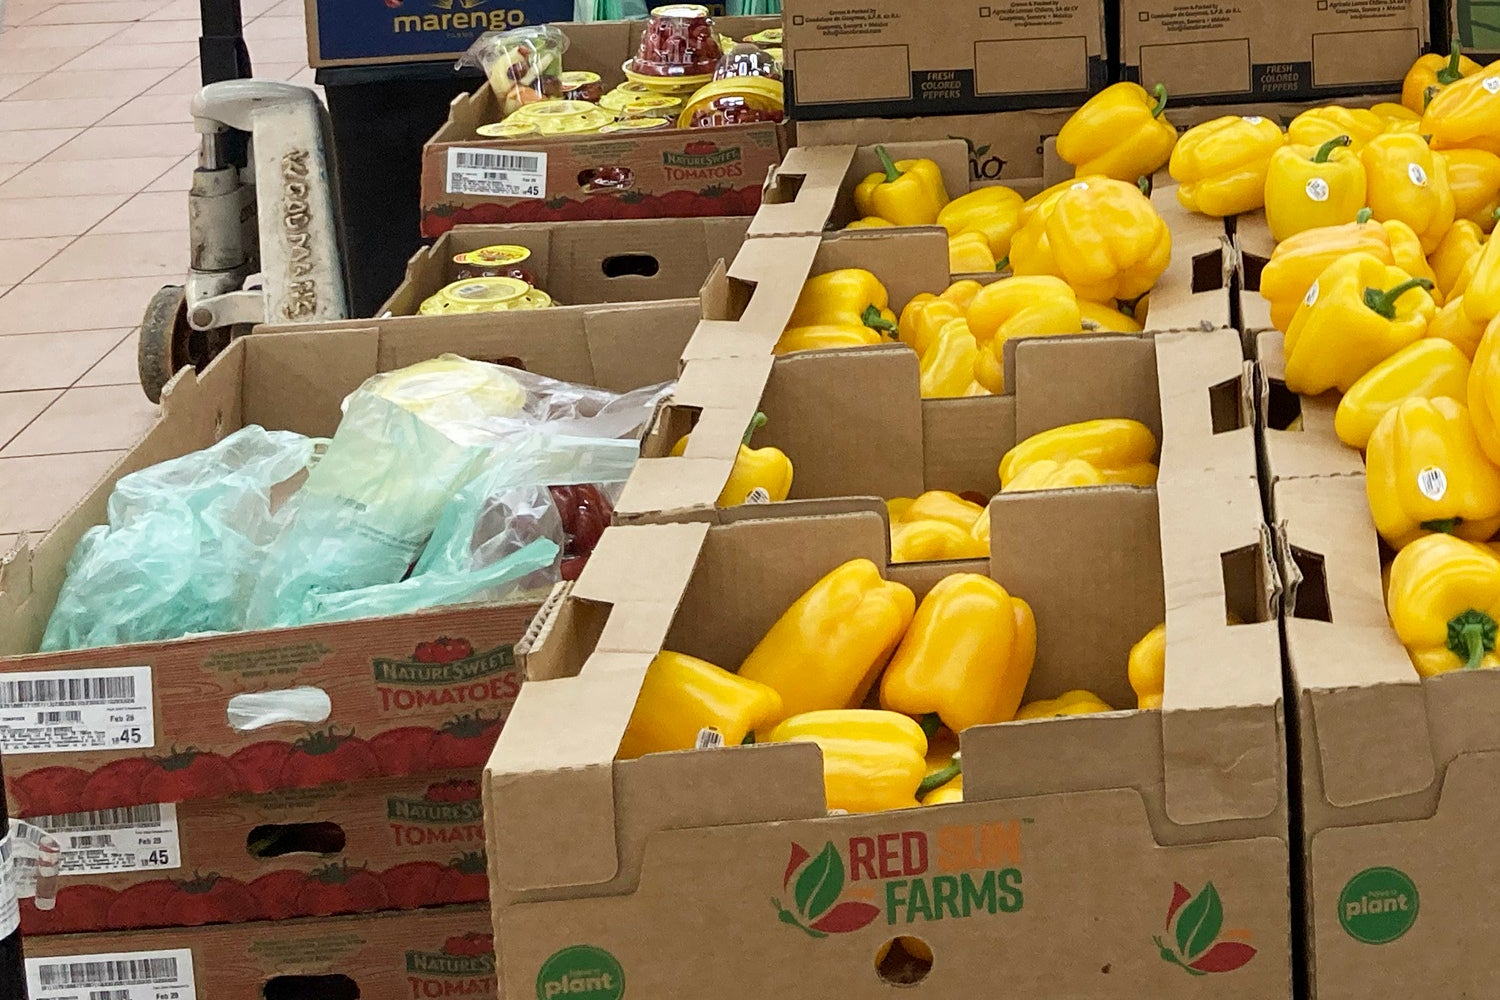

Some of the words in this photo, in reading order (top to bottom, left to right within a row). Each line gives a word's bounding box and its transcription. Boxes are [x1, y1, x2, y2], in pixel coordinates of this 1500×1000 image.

[393, 8, 525, 33] marengo
[928, 72, 955, 81] FRESH
[1261, 73, 1299, 83] COLORED
[1266, 65, 1293, 74] FRESH
[922, 81, 962, 91] COLORED
[922, 90, 961, 100] PEPPERS
[1262, 82, 1299, 92] PEPPERS
[664, 163, 743, 181] TOMATOES
[382, 652, 507, 680] NATURESWEET
[376, 672, 520, 712] TOMATOES
[849, 830, 928, 881] RED
[938, 820, 1022, 868] SUN
[886, 868, 1024, 926] FARMS
[1345, 892, 1409, 920] plant
[545, 972, 612, 998] plant
